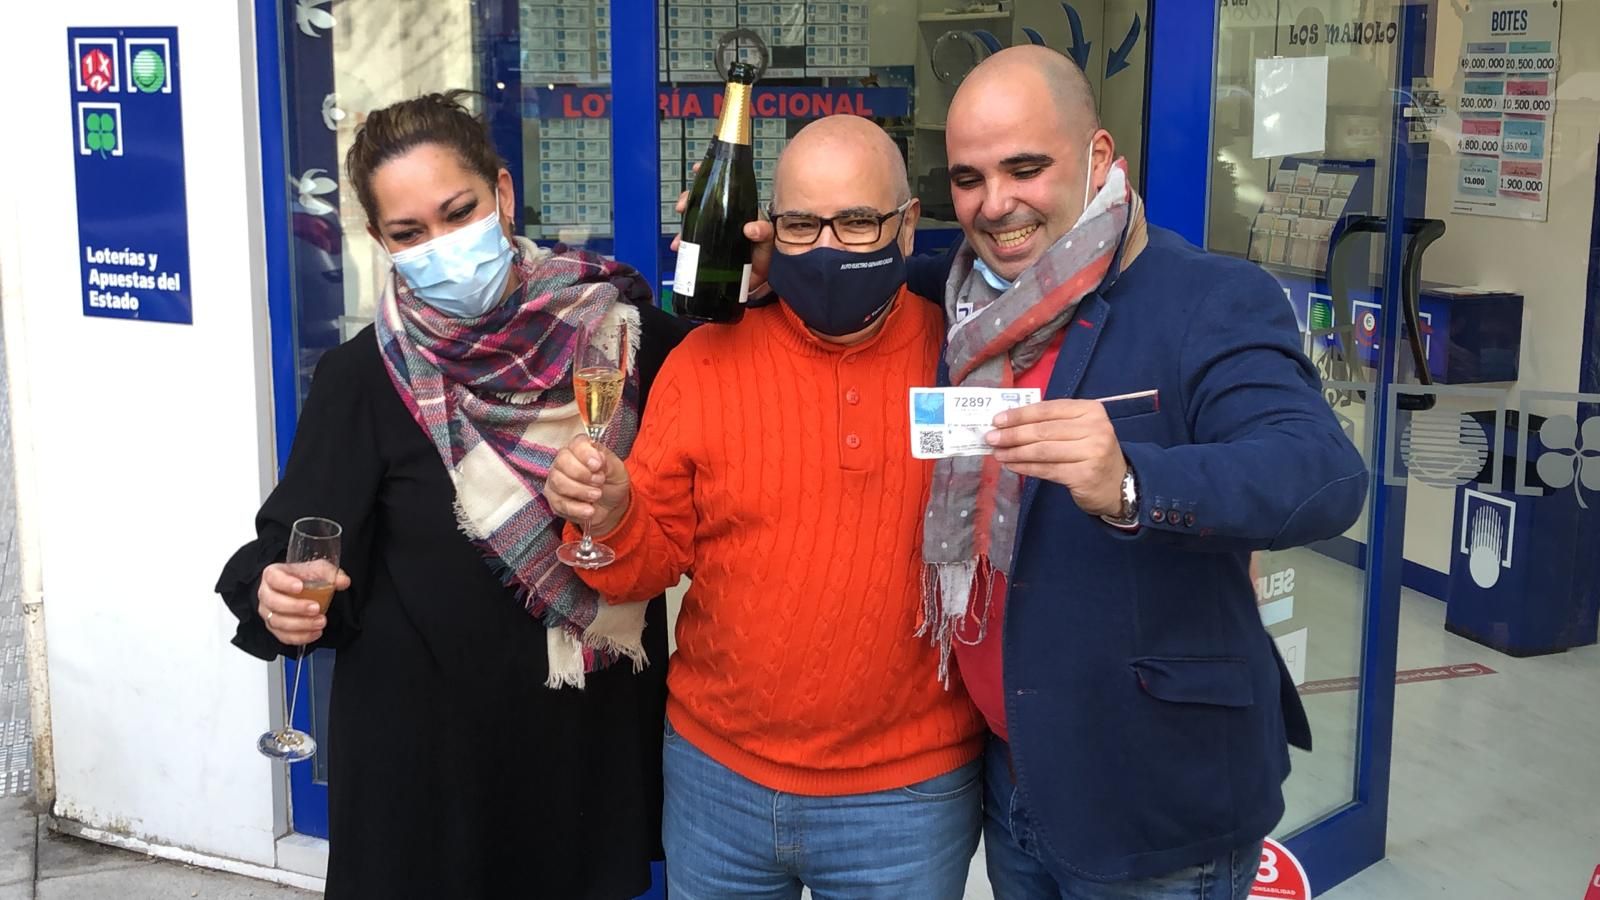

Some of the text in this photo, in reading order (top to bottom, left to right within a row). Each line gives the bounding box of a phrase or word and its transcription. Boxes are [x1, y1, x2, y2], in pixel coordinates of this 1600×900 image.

[1491, 10, 1528, 32] BOTES
[1289, 24, 1319, 45] LOS
[562, 87, 702, 118] LORÍA
[86, 246, 158, 272] Loterías y
[89, 268, 181, 291] Apuestas del
[89, 290, 140, 311] Estado
[954, 397, 992, 407] 72897
